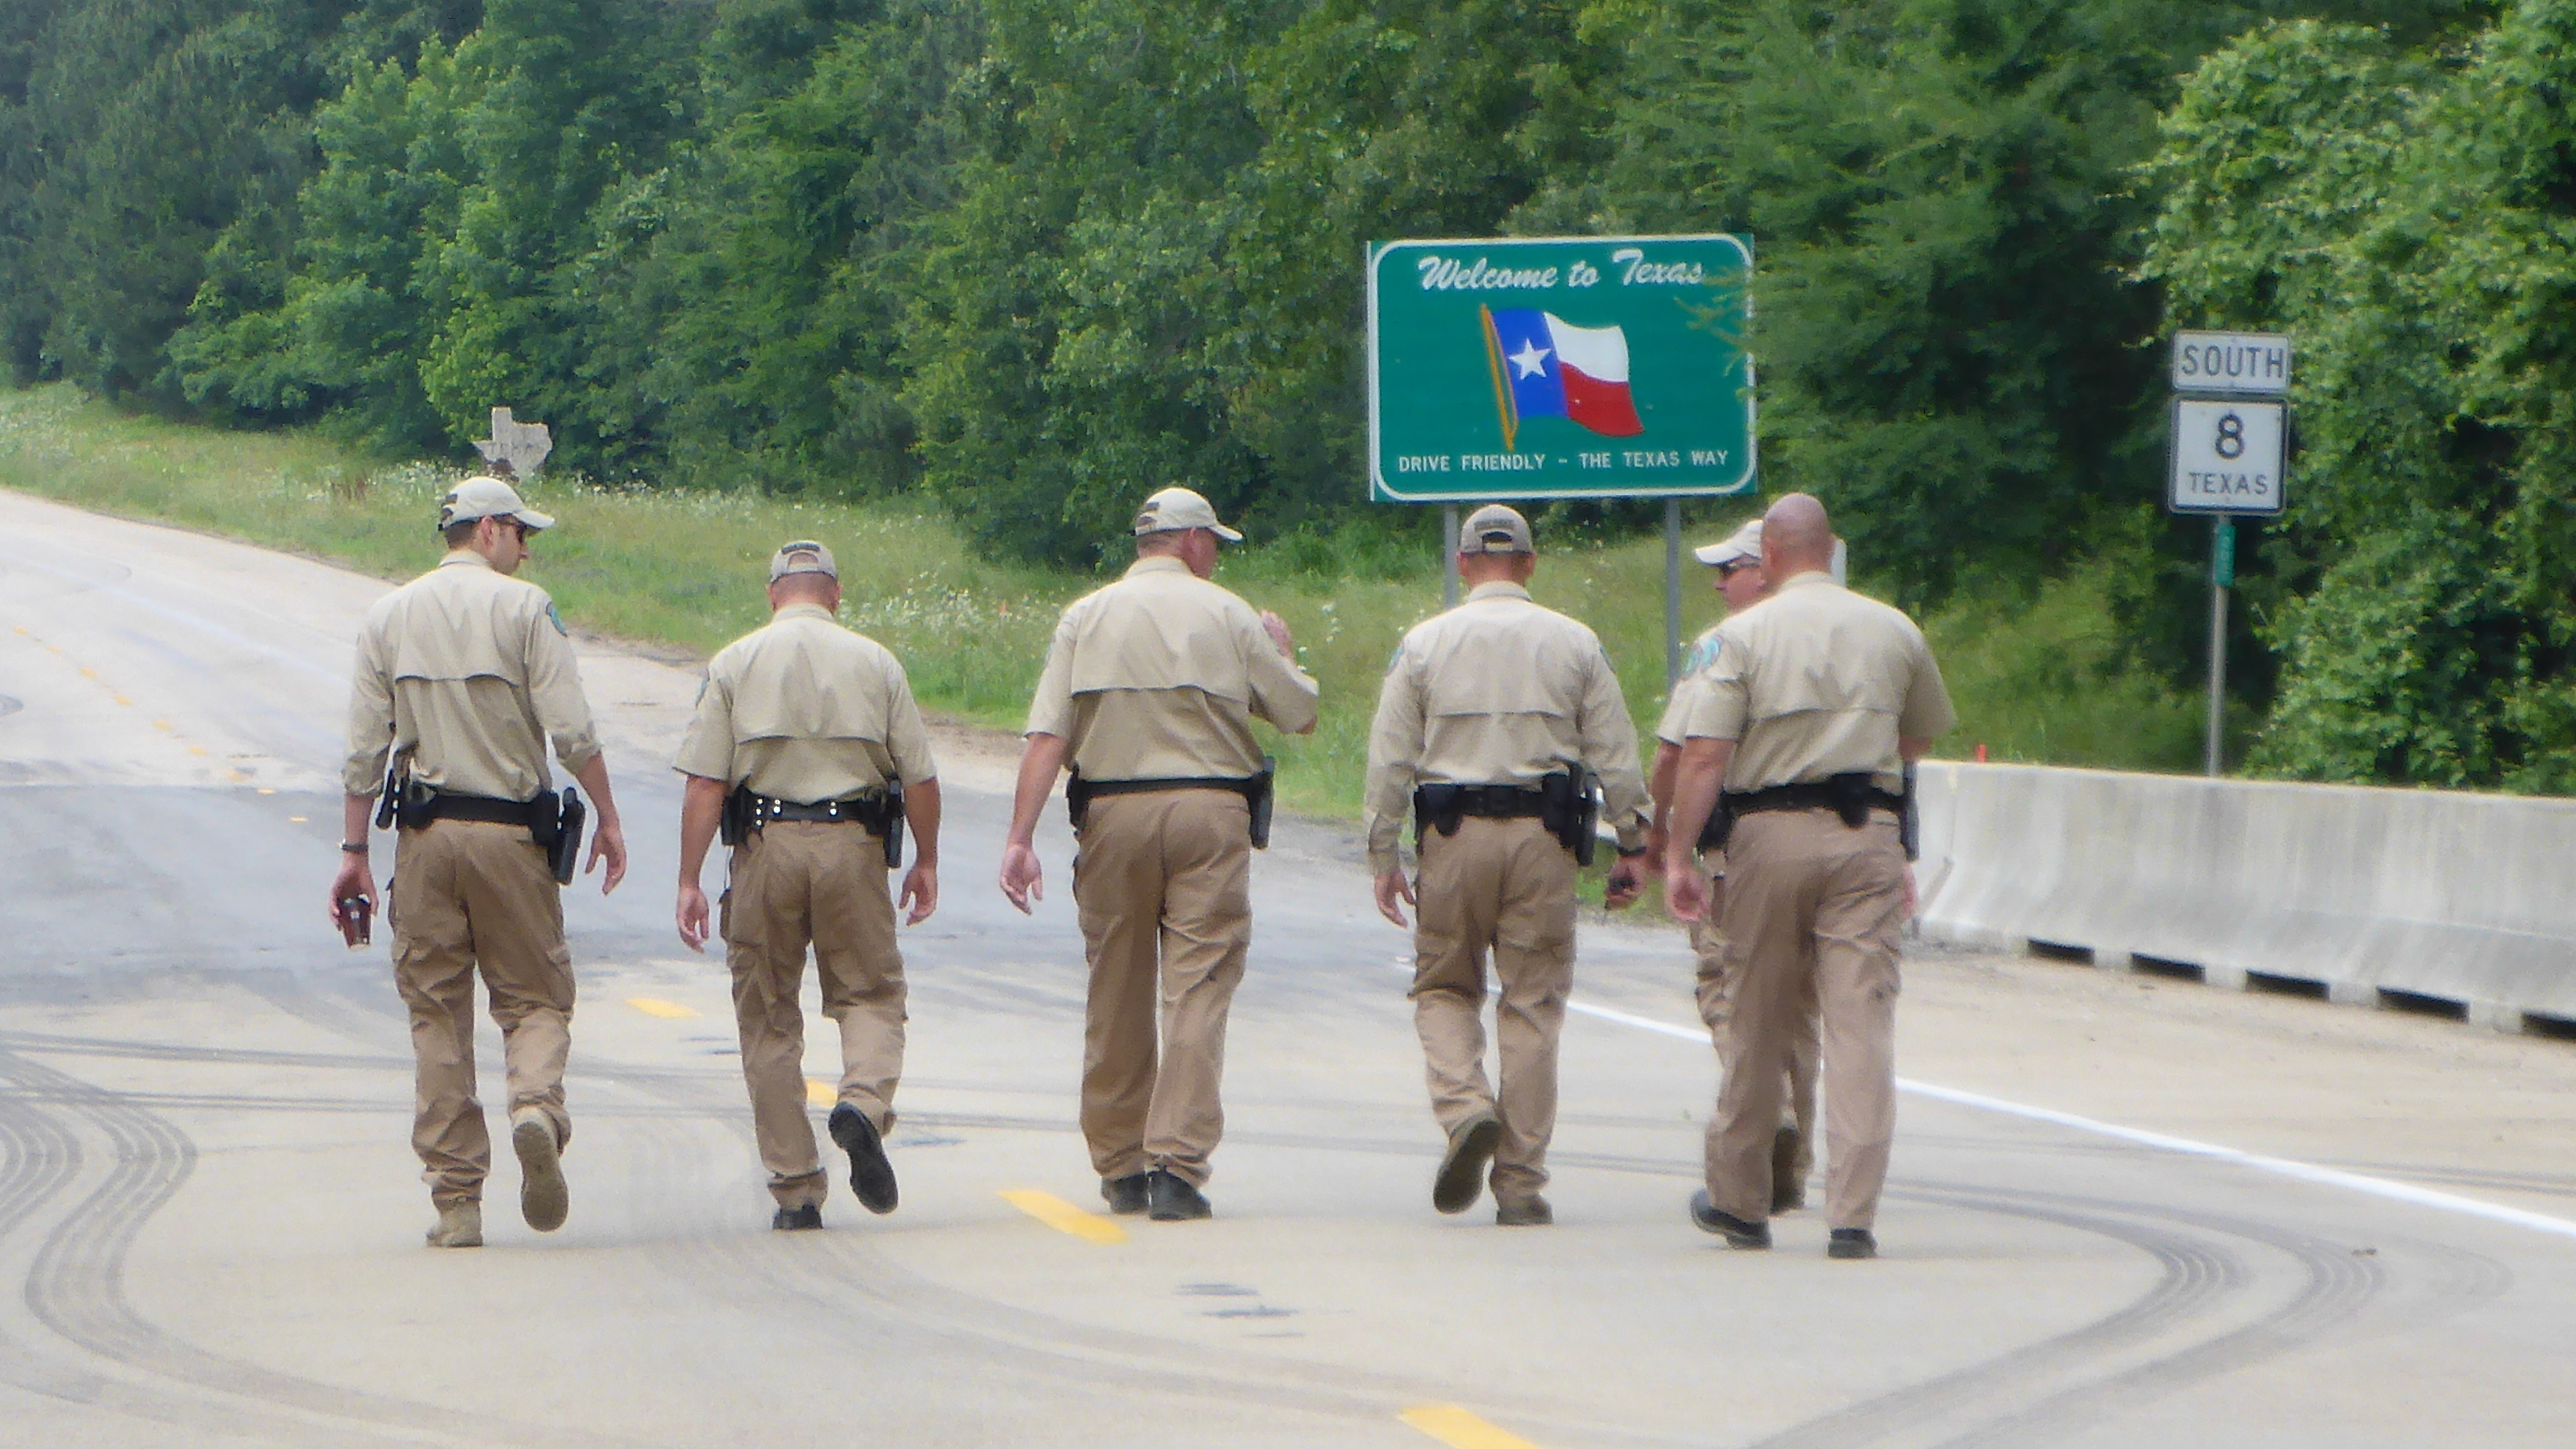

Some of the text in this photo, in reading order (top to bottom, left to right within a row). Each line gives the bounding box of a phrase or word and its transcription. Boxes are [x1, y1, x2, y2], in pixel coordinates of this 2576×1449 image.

[1418, 248, 1703, 291] Welcome to Texas
[2182, 344, 2284, 378] SOUTH
[2215, 413, 2244, 460] 8
[1399, 455, 1451, 472] DRIVE
[1461, 453, 1546, 471] FRIENDLY
[1578, 452, 1612, 470] THE
[1622, 451, 1680, 468] TEXAS
[1691, 450, 1727, 467] WAY
[2188, 471, 2269, 495] TEXAS
